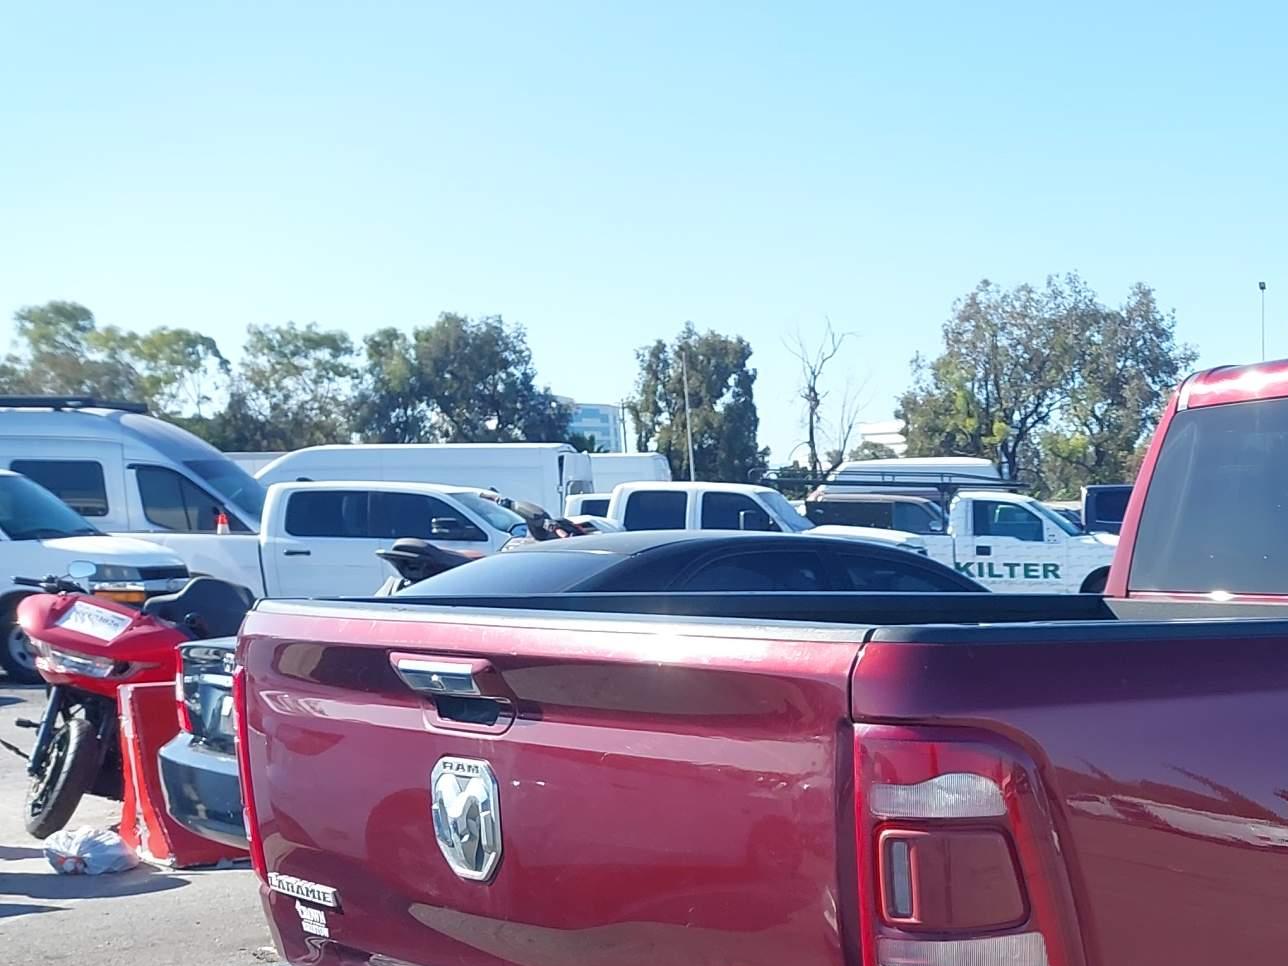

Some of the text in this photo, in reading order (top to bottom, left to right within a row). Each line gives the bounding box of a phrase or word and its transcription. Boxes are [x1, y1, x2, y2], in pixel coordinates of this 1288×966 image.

[954, 561, 1061, 579] KILTER
[442, 761, 480, 773] RAM
[268, 874, 334, 905] LARAMIE
